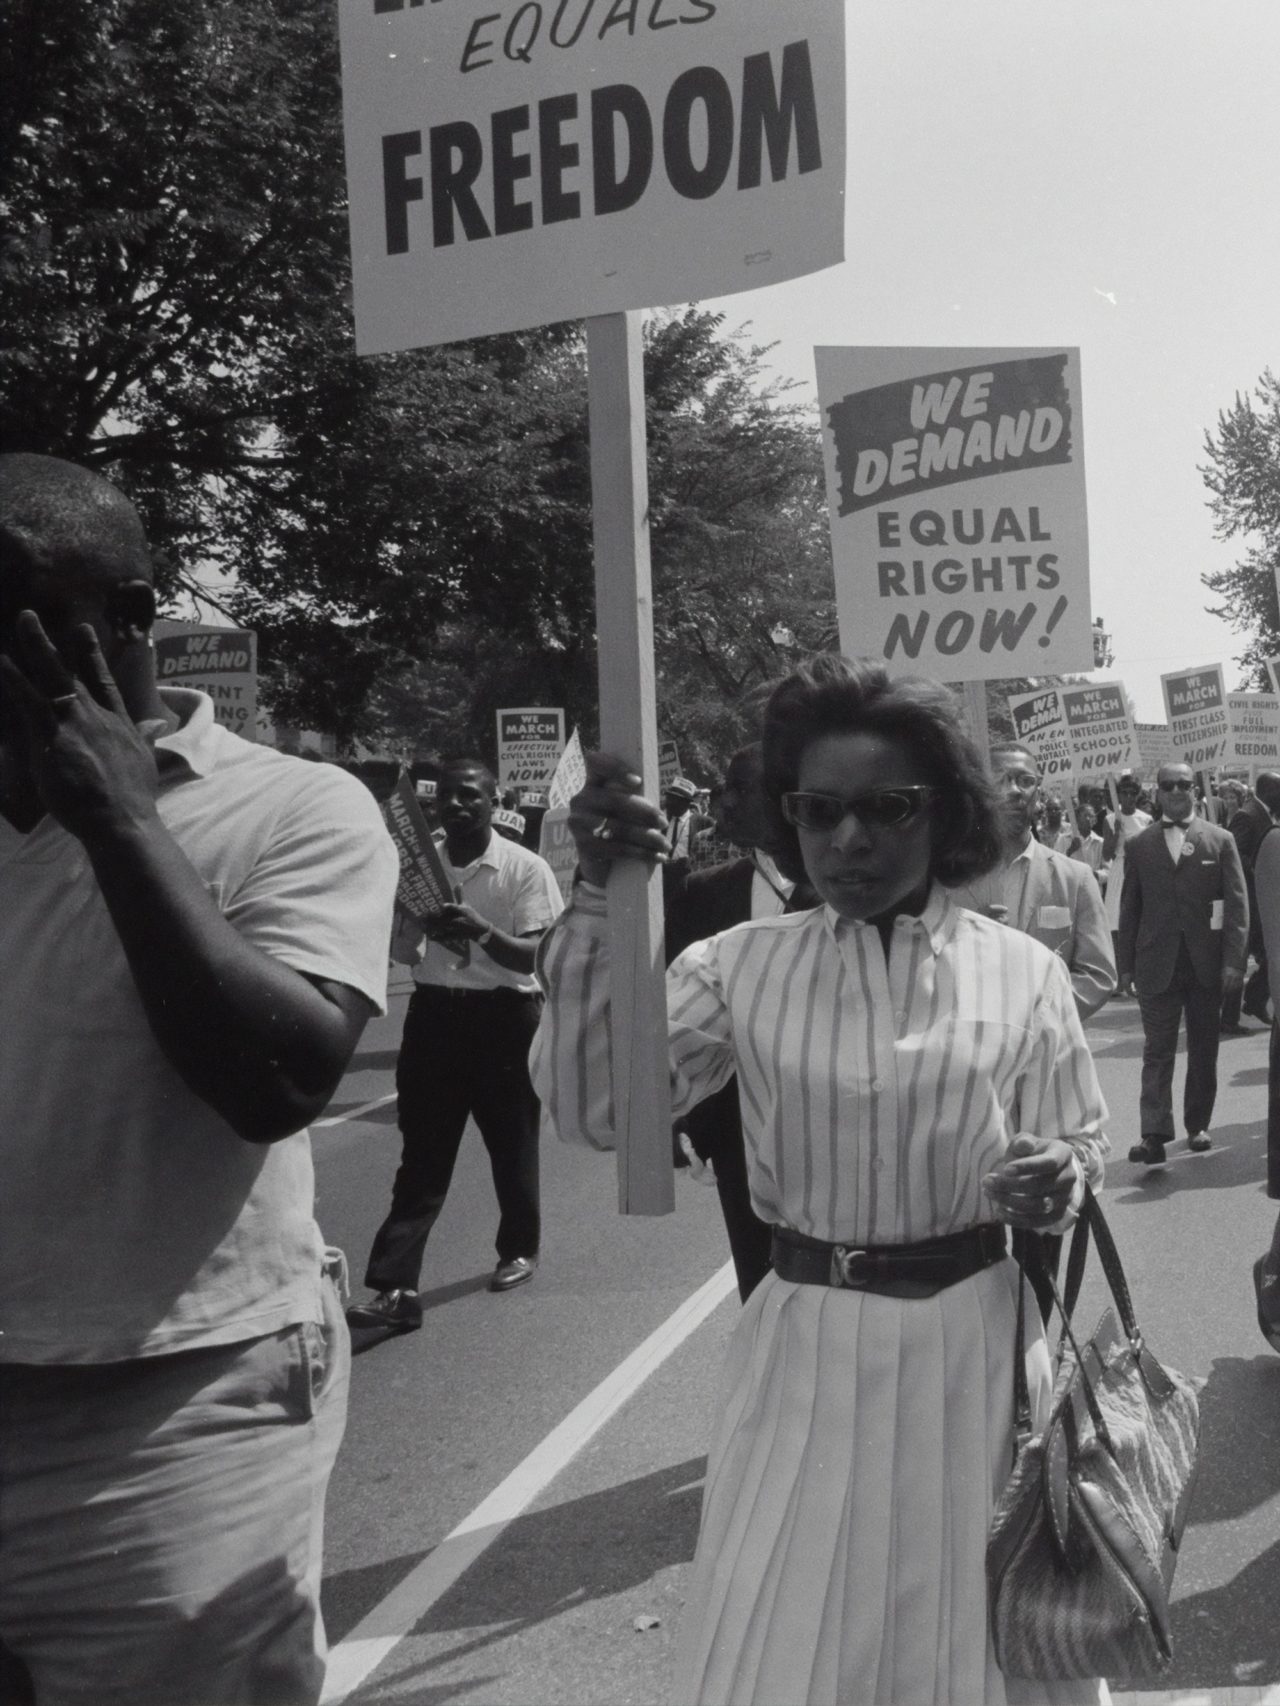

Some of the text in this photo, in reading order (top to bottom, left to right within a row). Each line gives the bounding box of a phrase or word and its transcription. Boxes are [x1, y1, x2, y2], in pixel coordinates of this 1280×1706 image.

[381, 38, 823, 256] FREEDOM
[910, 371, 994, 430] WE
[853, 406, 1064, 498] DEMAND
[877, 506, 1052, 549] EQUAL
[877, 552, 1061, 598] RIGHTS
[883, 594, 1069, 660] NOW!
[186, 635, 222, 653] WE
[163, 650, 248, 675] DEMAND
[1185, 676, 1201, 688] WE
[1033, 693, 1056, 713] WE
[1083, 691, 1102, 702] WE
[1173, 684, 1218, 707] MARCH
[1228, 700, 1249, 709] CIVIL
[1251, 700, 1280, 710] RIGHTS
[1070, 698, 1120, 717] MARCH
[1086, 712, 1108, 721] FOR
[521, 714, 539, 724] WE
[1172, 717, 1198, 733] FIRST
[1199, 710, 1226, 723] CLASS
[1242, 716, 1264, 726] FULL
[505, 723, 556, 735] MARCH
[1028, 729, 1066, 743] AN EN
[1069, 720, 1129, 739] INTEGRATED
[1172, 723, 1229, 746] CITIZENSHIP
[506, 743, 558, 752] EFFECTIVE
[1073, 734, 1132, 753] SCHOOLS
[1183, 739, 1227, 765] NOW!
[1234, 743, 1278, 757] REEDOM
[501, 751, 562, 761] CIVIL RIGHTS
[516, 760, 546, 768] LAWS
[1033, 748, 1071, 762] RUTALIT
[1081, 746, 1132, 770] NOW!
[506, 768, 557, 782] NOW!
[409, 874, 440, 913] FREEDO
